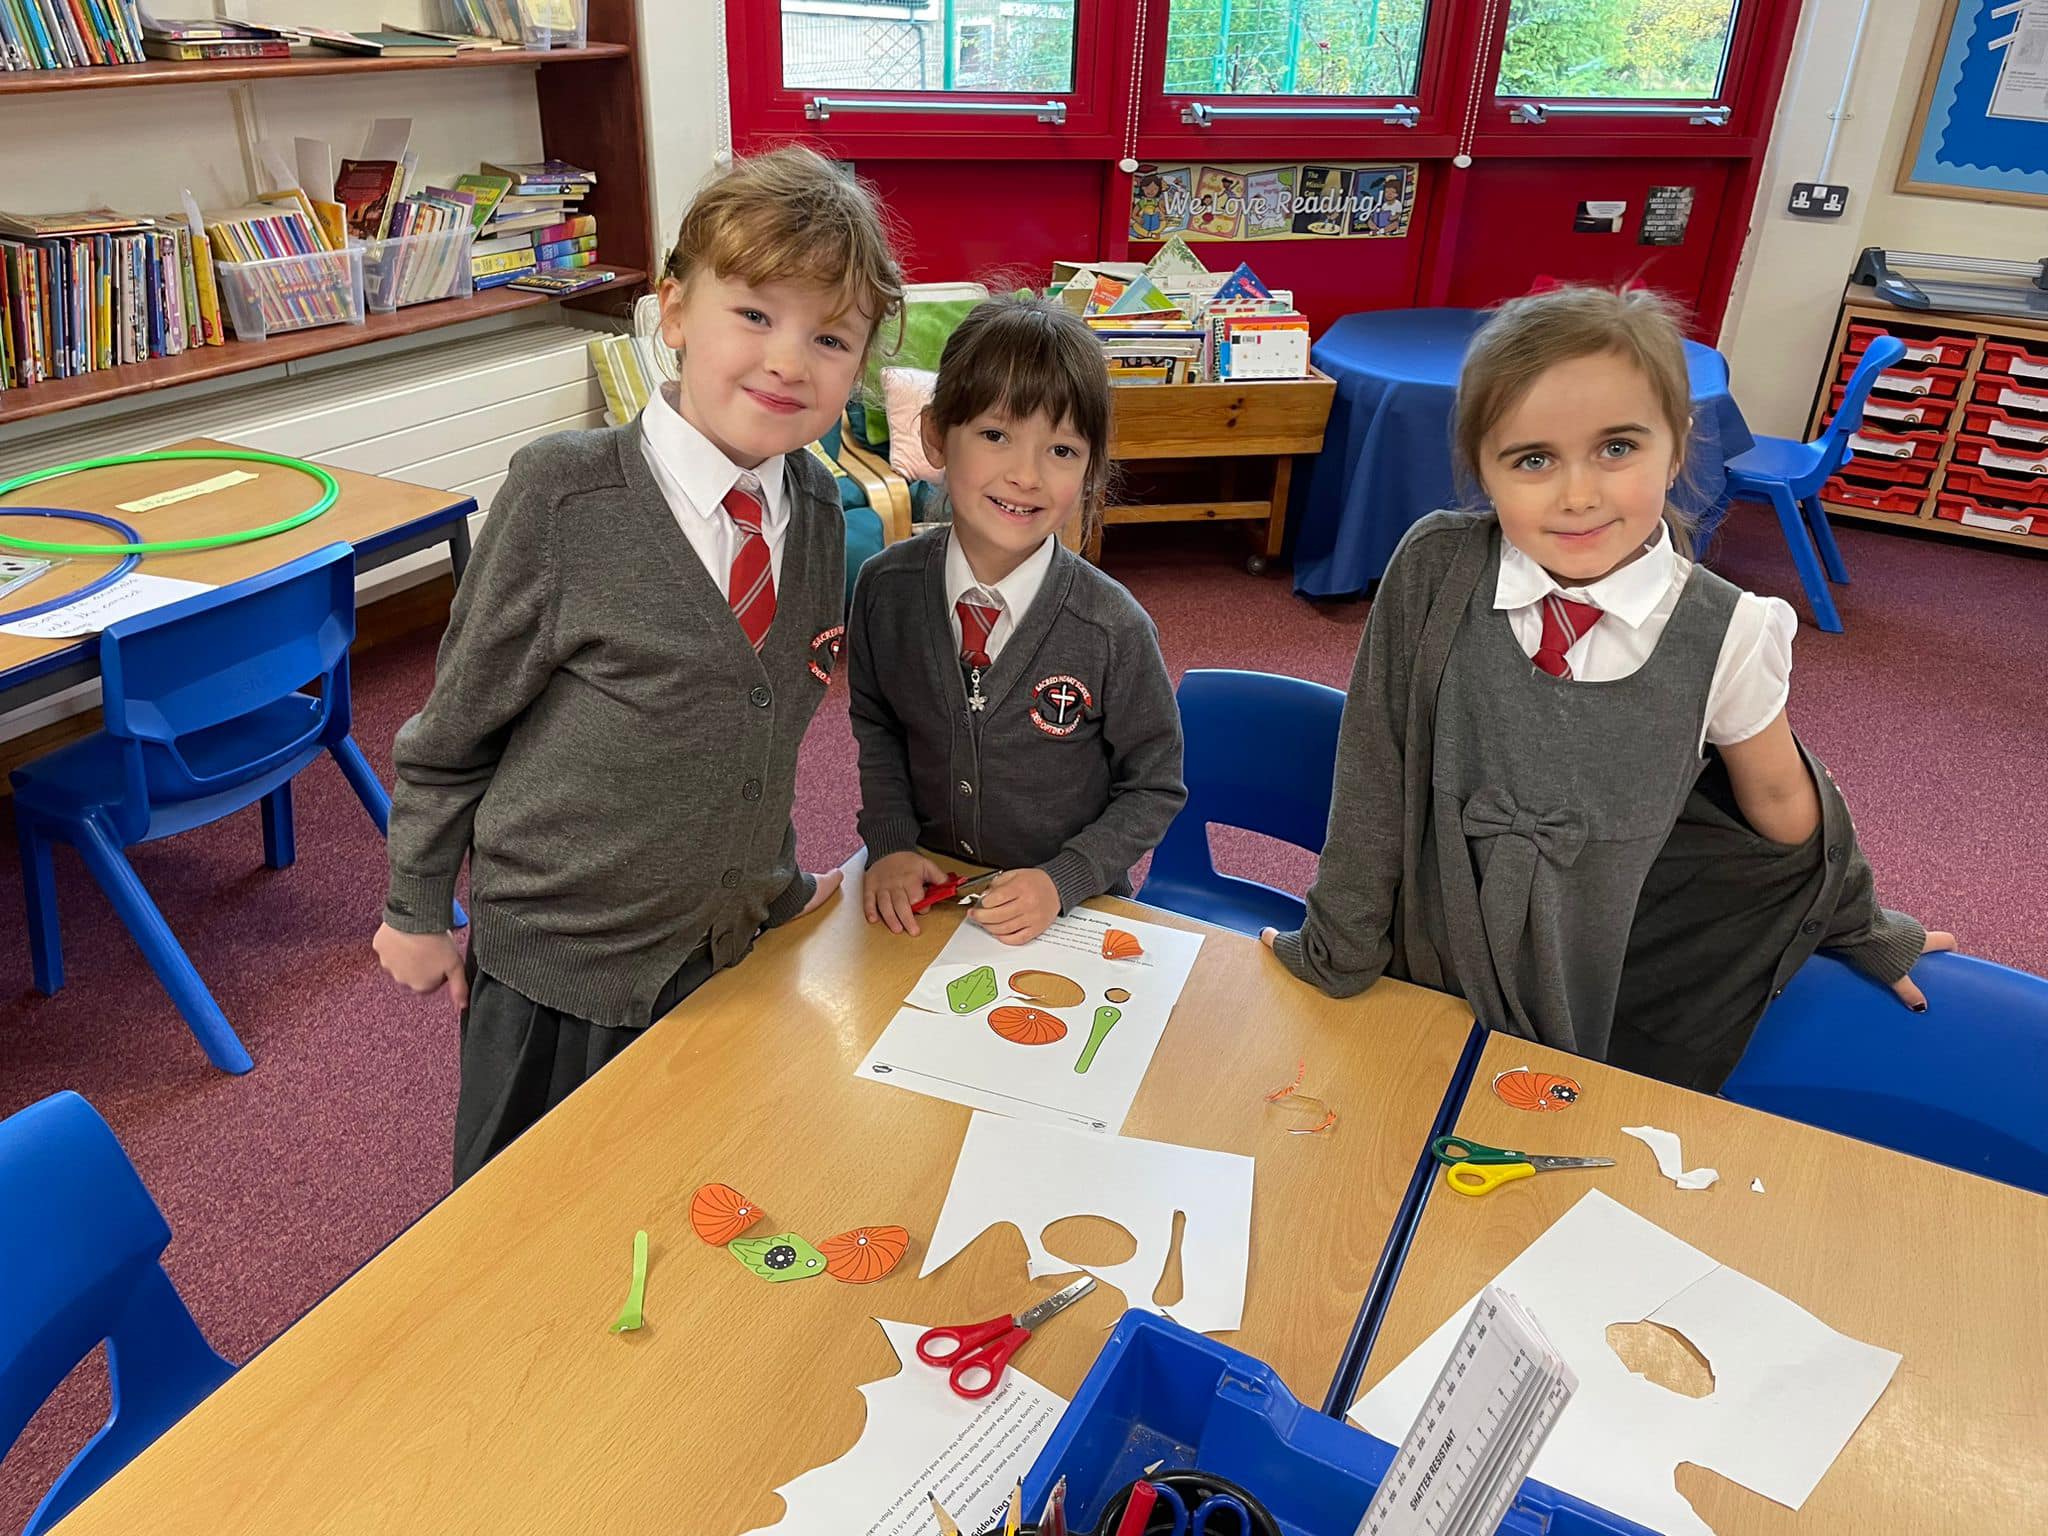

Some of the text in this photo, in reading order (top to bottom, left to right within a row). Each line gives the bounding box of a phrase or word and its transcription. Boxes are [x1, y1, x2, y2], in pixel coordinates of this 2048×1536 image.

[1162, 188, 1385, 221] We Love Reading!
[1417, 1437, 1425, 1451] 230
[1427, 1419, 1435, 1433] 240
[1437, 1401, 1445, 1414] 250
[1457, 1363, 1466, 1377] 270
[1488, 1306, 1497, 1320] 300
[995, 1388, 1008, 1401] Place
[981, 1405, 992, 1415] split
[1003, 1396, 1021, 1415] Arrange
[1020, 1404, 1035, 1419] Using
[974, 1414, 983, 1423] pin
[996, 1415, 1005, 1423] the
[1028, 1412, 1049, 1435] Carefully
[957, 1422, 975, 1441] through
[983, 1422, 997, 1437] pieces
[1008, 1424, 1019, 1434] hole
[1021, 1435, 1030, 1444] cut
[949, 1441, 958, 1450] the
[968, 1443, 979, 1454] that
[1014, 1443, 1022, 1452] out
[939, 1450, 950, 1460] hole
[960, 1453, 969, 1461] the
[981, 1449, 995, 1463] create
[1006, 1451, 1016, 1460] the
[929, 1460, 940, 1471] and
[948, 1461, 962, 1474] holes
[968, 1463, 983, 1476] holes
[993, 1459, 1007, 1474] pieces
[1410, 1429, 1456, 1510] SHATTER RESISTANT
[920, 1468, 932, 1480] fold
[939, 1474, 950, 1484] line
[912, 1480, 920, 1489] out
[932, 1483, 940, 1491] up
[955, 1482, 964, 1491] the
[981, 1480, 990, 1488] the
[903, 1488, 913, 1497] the
[941, 1490, 956, 1505] pieces
[965, 1487, 981, 1504] poppy
[918, 1497, 928, 1506] the
[906, 1506, 919, 1520] order
[952, 1504, 967, 1519] along
[971, 1500, 1010, 1536] Day Poppy
